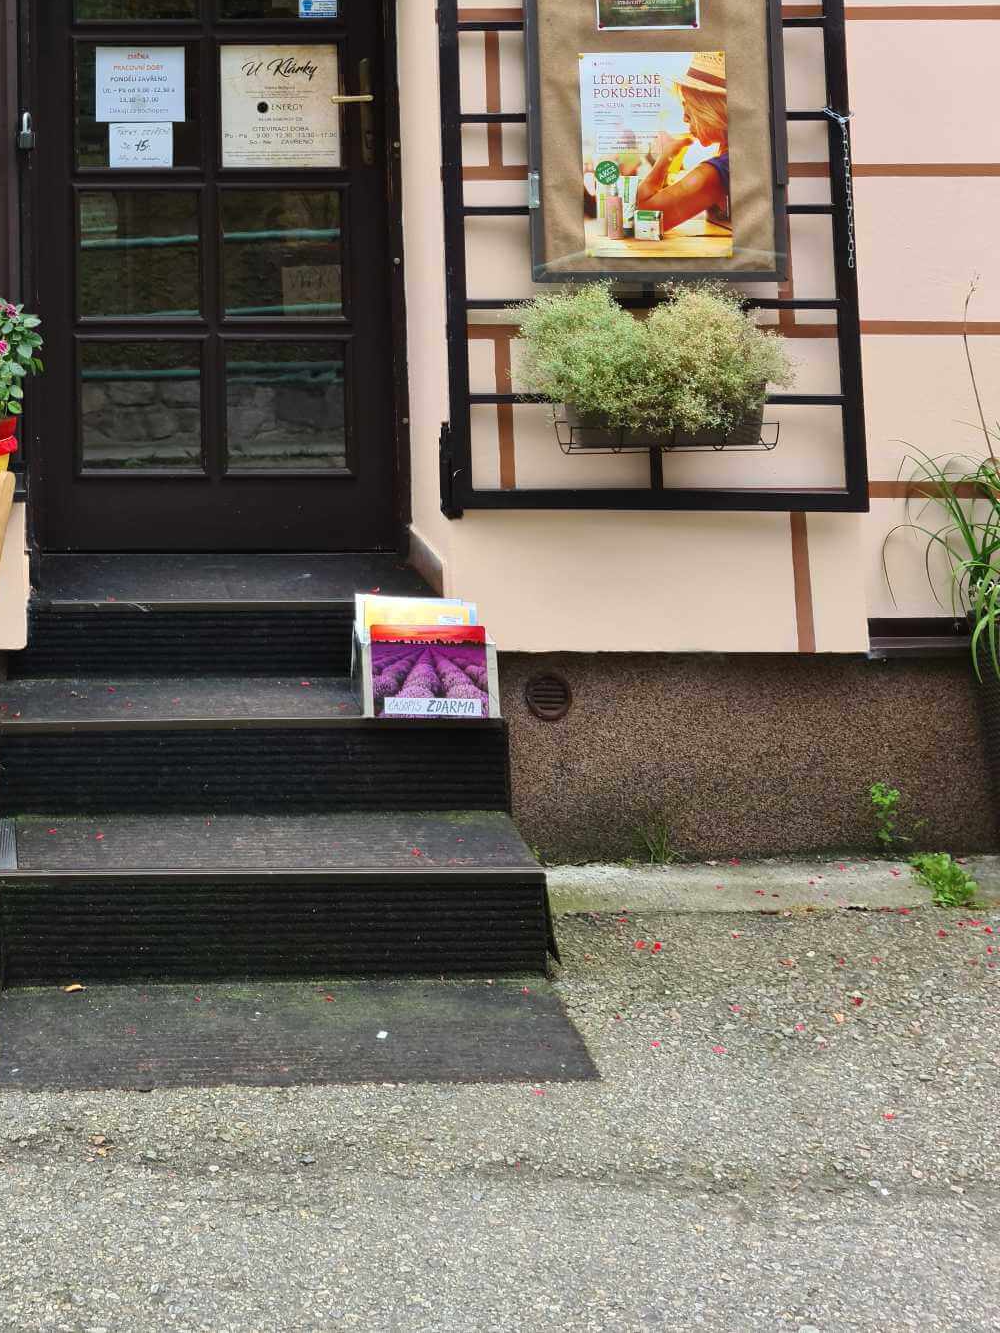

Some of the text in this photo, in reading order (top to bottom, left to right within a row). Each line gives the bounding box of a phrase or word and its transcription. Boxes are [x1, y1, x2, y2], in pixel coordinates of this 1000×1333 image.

[241, 57, 319, 82] U Klárky
[592, 72, 661, 85] LÉTO PLNÉ
[593, 86, 661, 99] POKUŠENÍ!
[426, 699, 475, 714] ZDARMA
